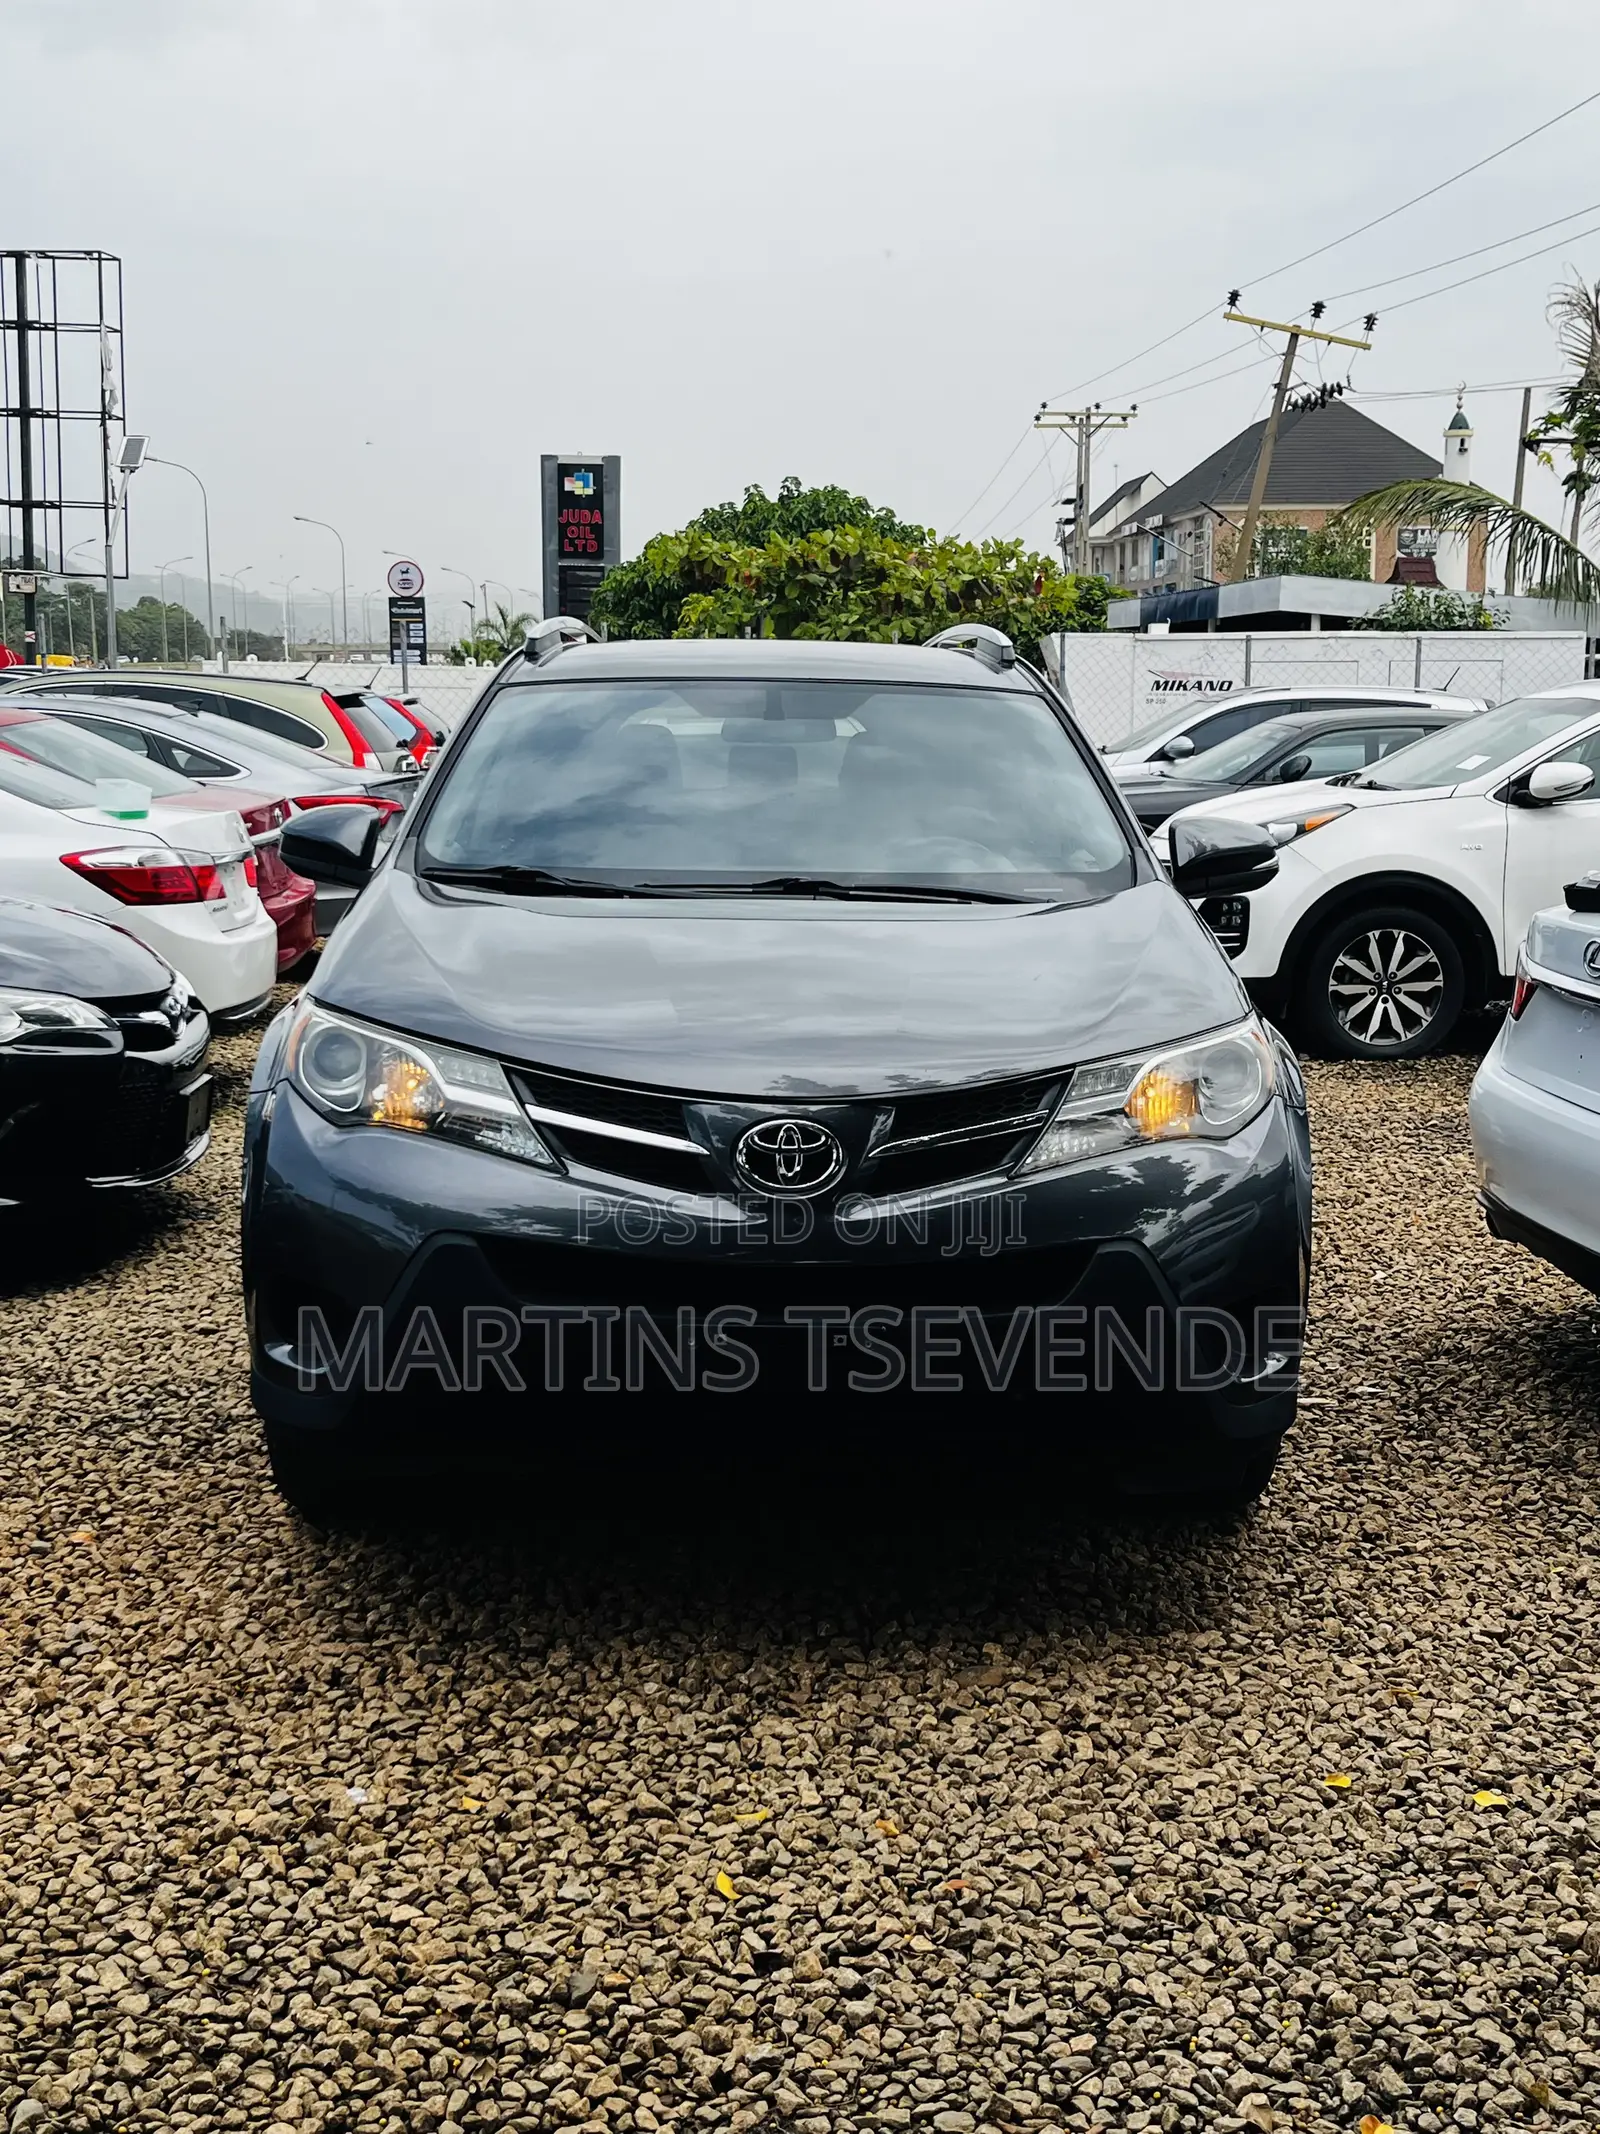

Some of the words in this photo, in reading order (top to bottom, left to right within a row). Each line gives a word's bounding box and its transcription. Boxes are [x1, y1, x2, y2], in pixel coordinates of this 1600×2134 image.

[558, 509, 602, 523] JUDA
[567, 526, 595, 539] OIL
[563, 539, 598, 552] LTD
[1151, 680, 1233, 691] MIKANO
